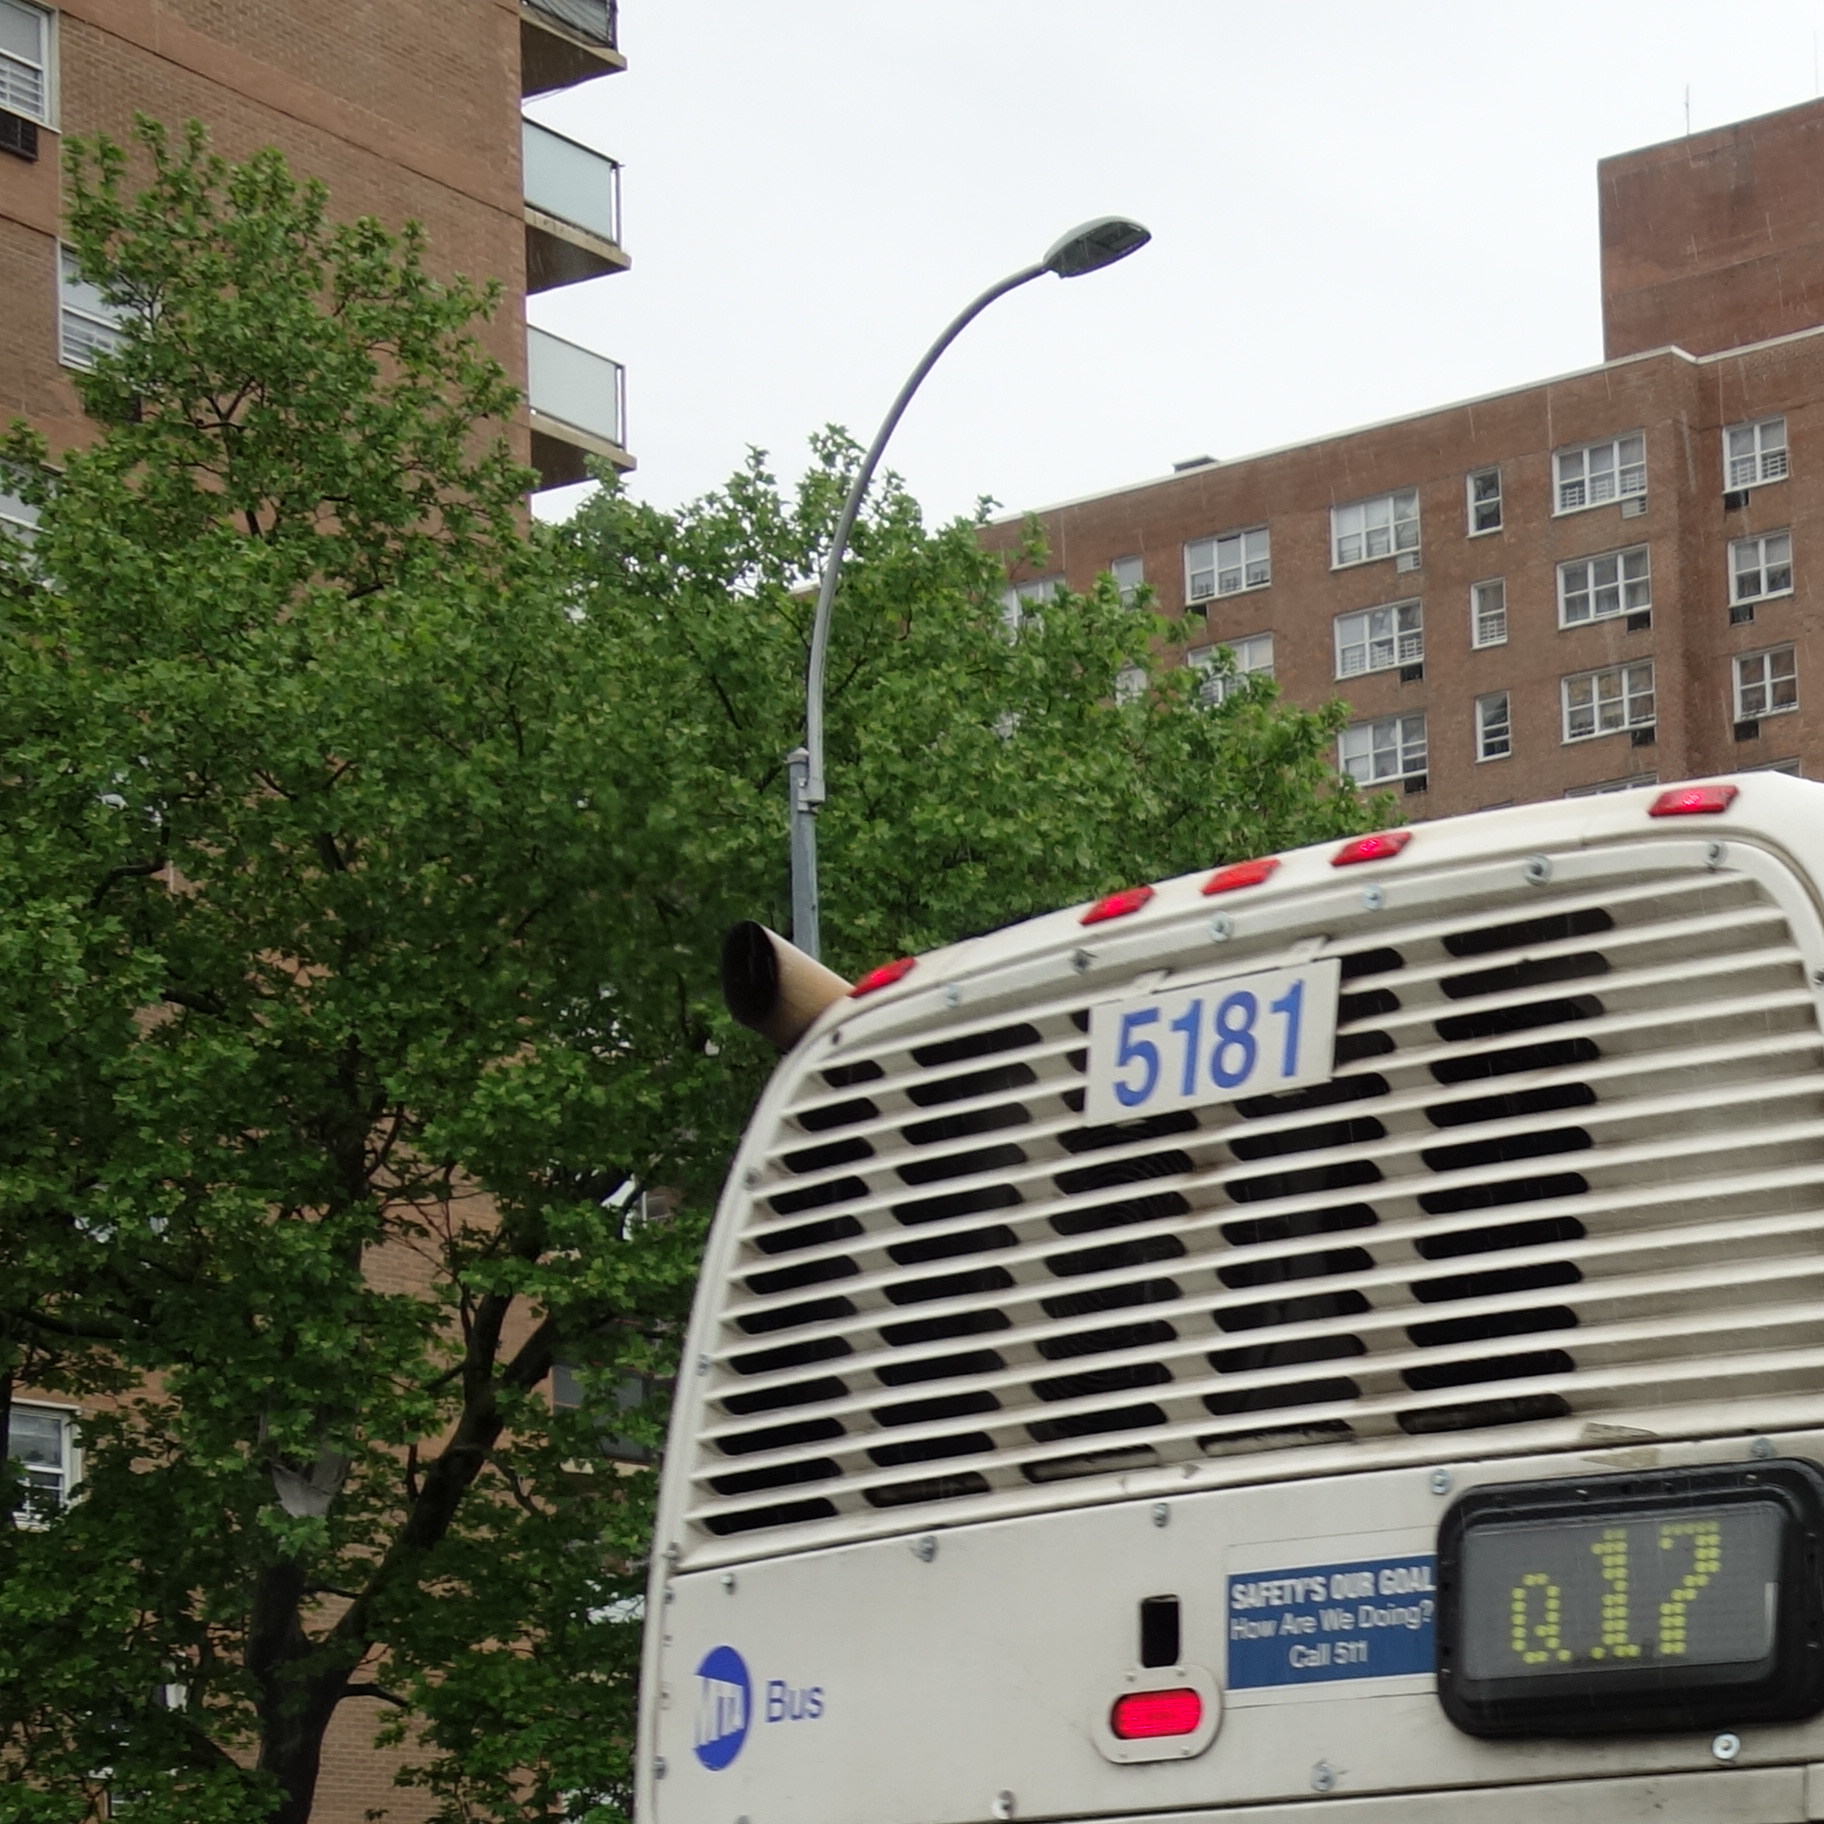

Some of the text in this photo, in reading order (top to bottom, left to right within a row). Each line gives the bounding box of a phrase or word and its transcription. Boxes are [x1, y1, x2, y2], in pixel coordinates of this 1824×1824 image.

[1112, 978, 1306, 1108] 5181
[1231, 1566, 1437, 1610] SAFETY'S OUR GOAL
[1230, 1599, 1435, 1640] How Are We Doing?
[1289, 1640, 1368, 1668] Call 511
[692, 1668, 825, 1754] MTA Bus
